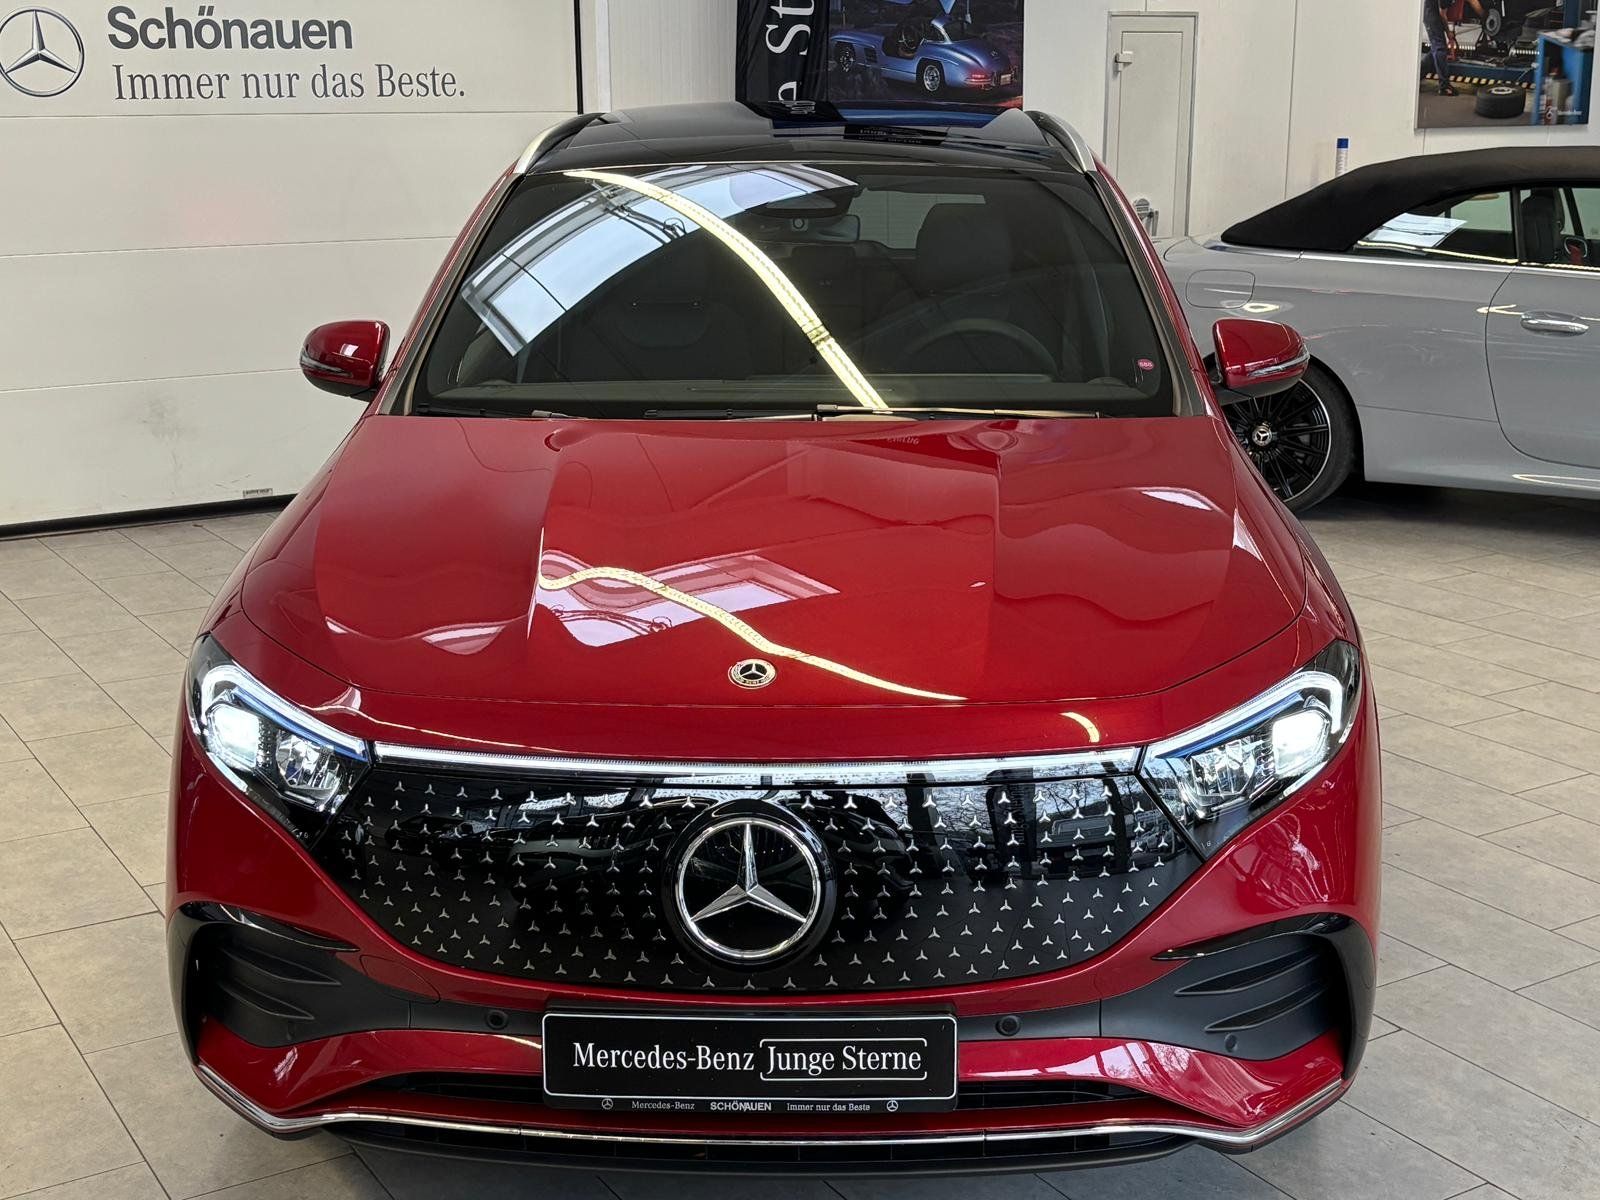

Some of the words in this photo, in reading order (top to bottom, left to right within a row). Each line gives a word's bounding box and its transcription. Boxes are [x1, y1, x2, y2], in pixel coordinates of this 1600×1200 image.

[107, 5, 353, 50] Schönauen
[114, 64, 230, 100] Immer
[240, 72, 300, 99] nur
[311, 63, 365, 99] das
[375, 63, 465, 98] Beste.
[572, 1042, 755, 1071] Mercedes-Benz
[766, 1046, 835, 1076] Junge
[842, 1045, 922, 1070] Sterne
[631, 1101, 695, 1110] Mercedes-Benz
[710, 1100, 772, 1112] SCHÖNAUEN
[786, 1102, 814, 1111] Immer
[815, 1103, 831, 1111] nur
[832, 1102, 847, 1112] das
[848, 1103, 871, 1112] Beste
